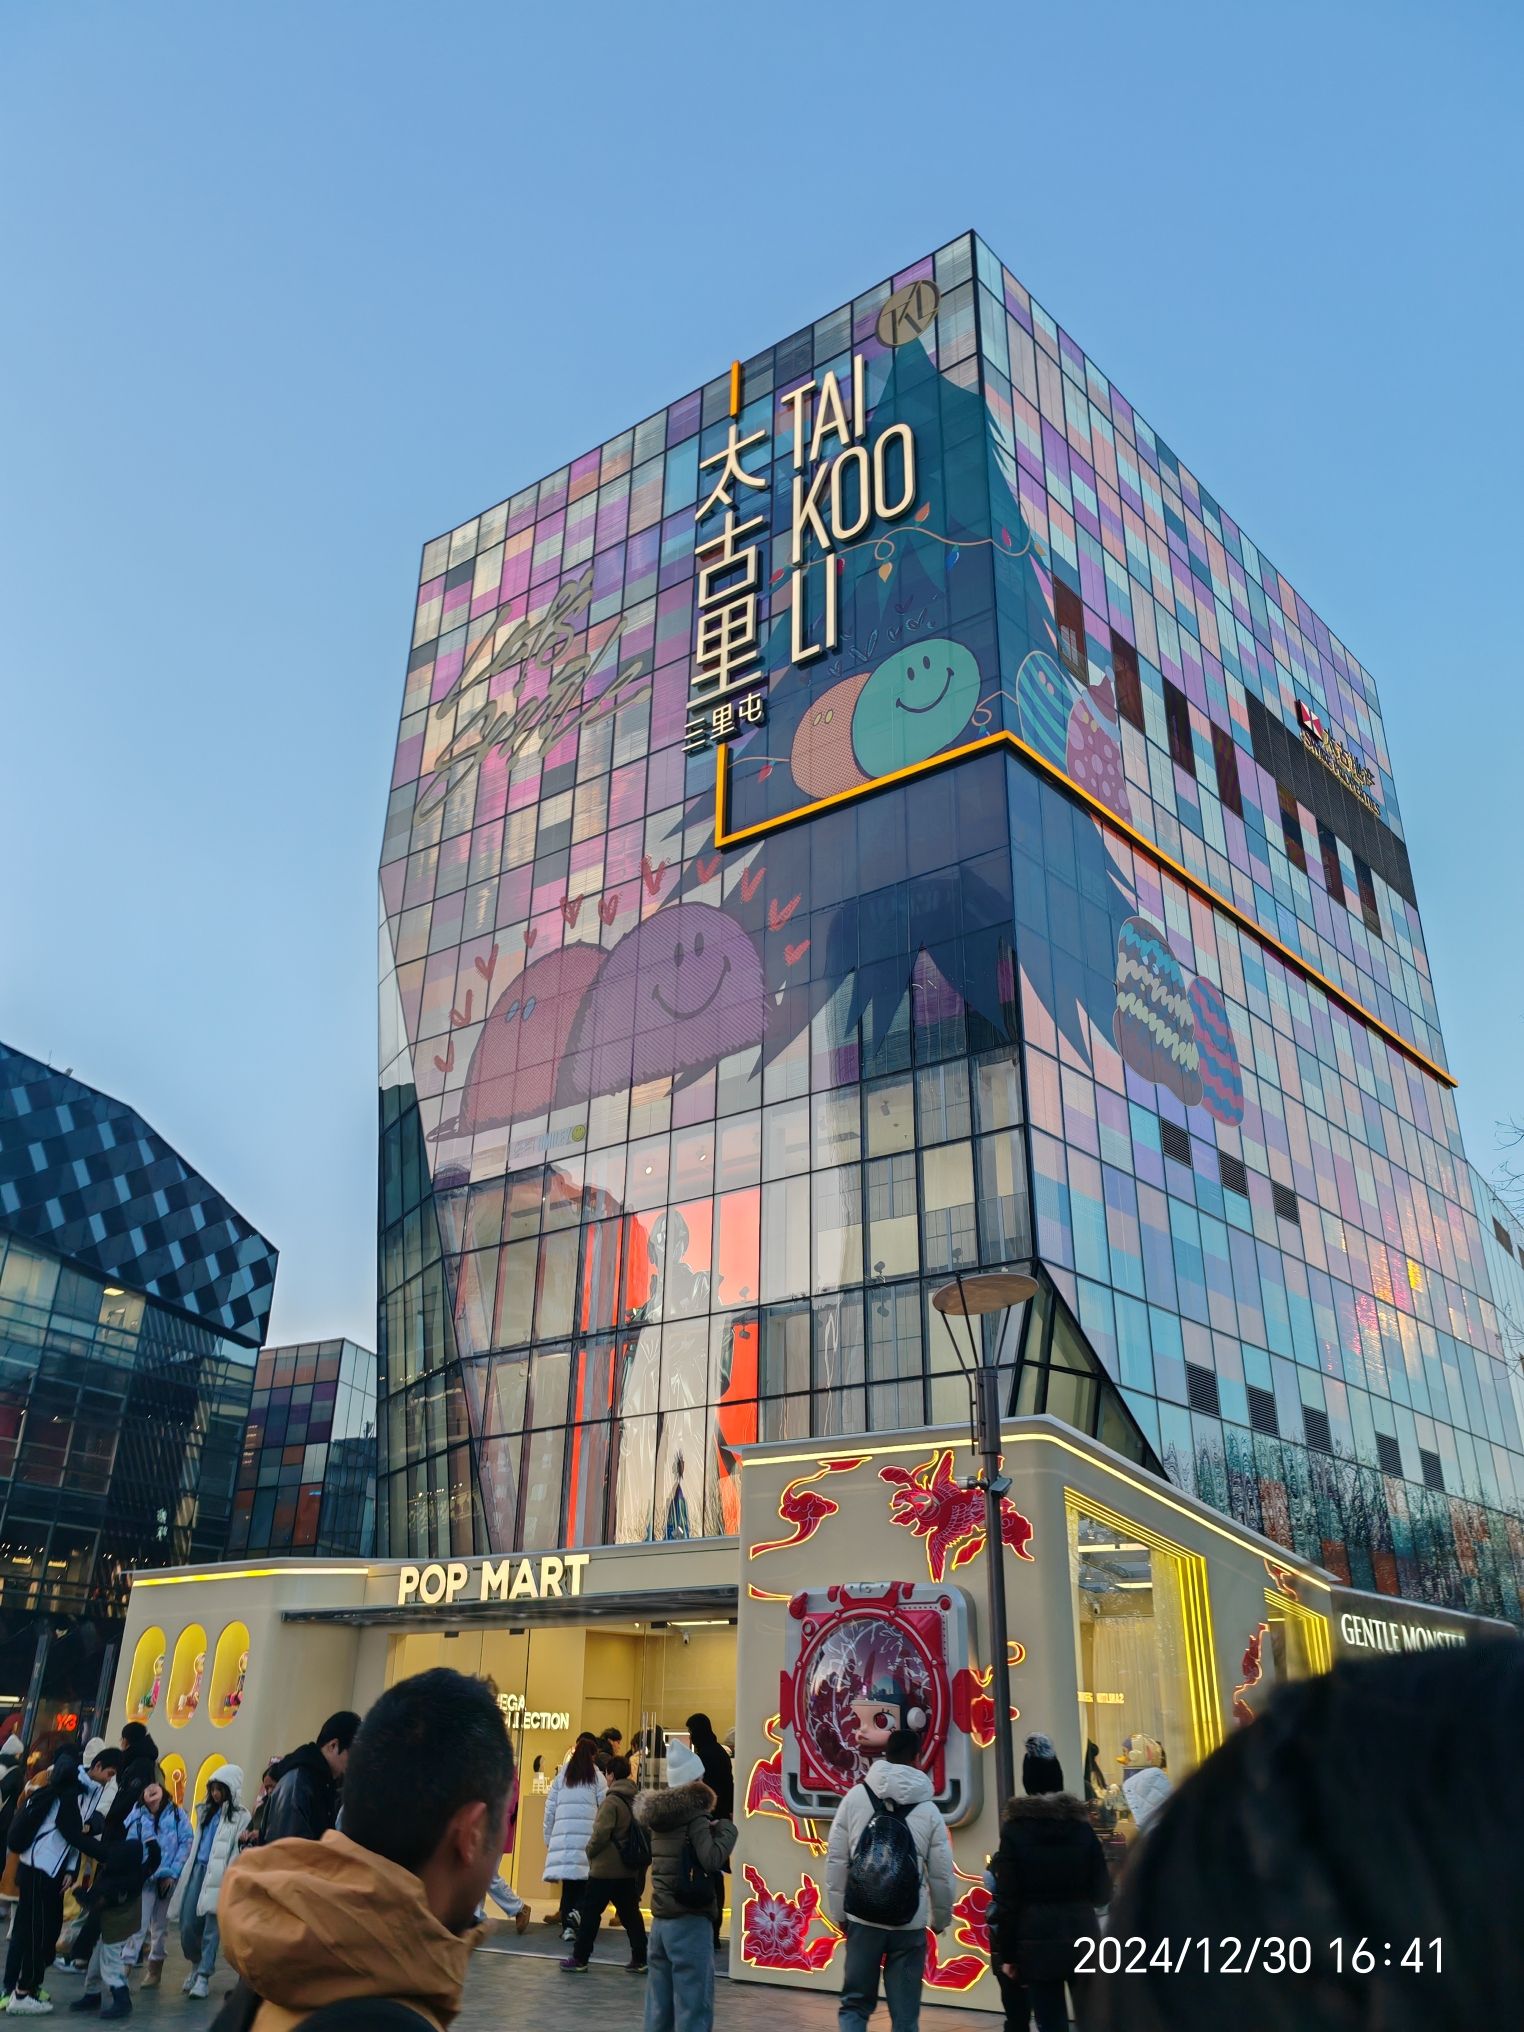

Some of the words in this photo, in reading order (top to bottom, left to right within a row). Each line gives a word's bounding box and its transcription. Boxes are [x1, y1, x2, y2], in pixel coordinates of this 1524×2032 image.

[780, 354, 865, 470] TAI
[792, 423, 916, 566] KOO
[686, 424, 767, 710] 太古里
[791, 553, 838, 665] LI
[681, 692, 763, 752] 三里屯
[398, 1563, 468, 1605] POP
[480, 1554, 590, 1600] MART
[1341, 1613, 1401, 1652] GENTLE
